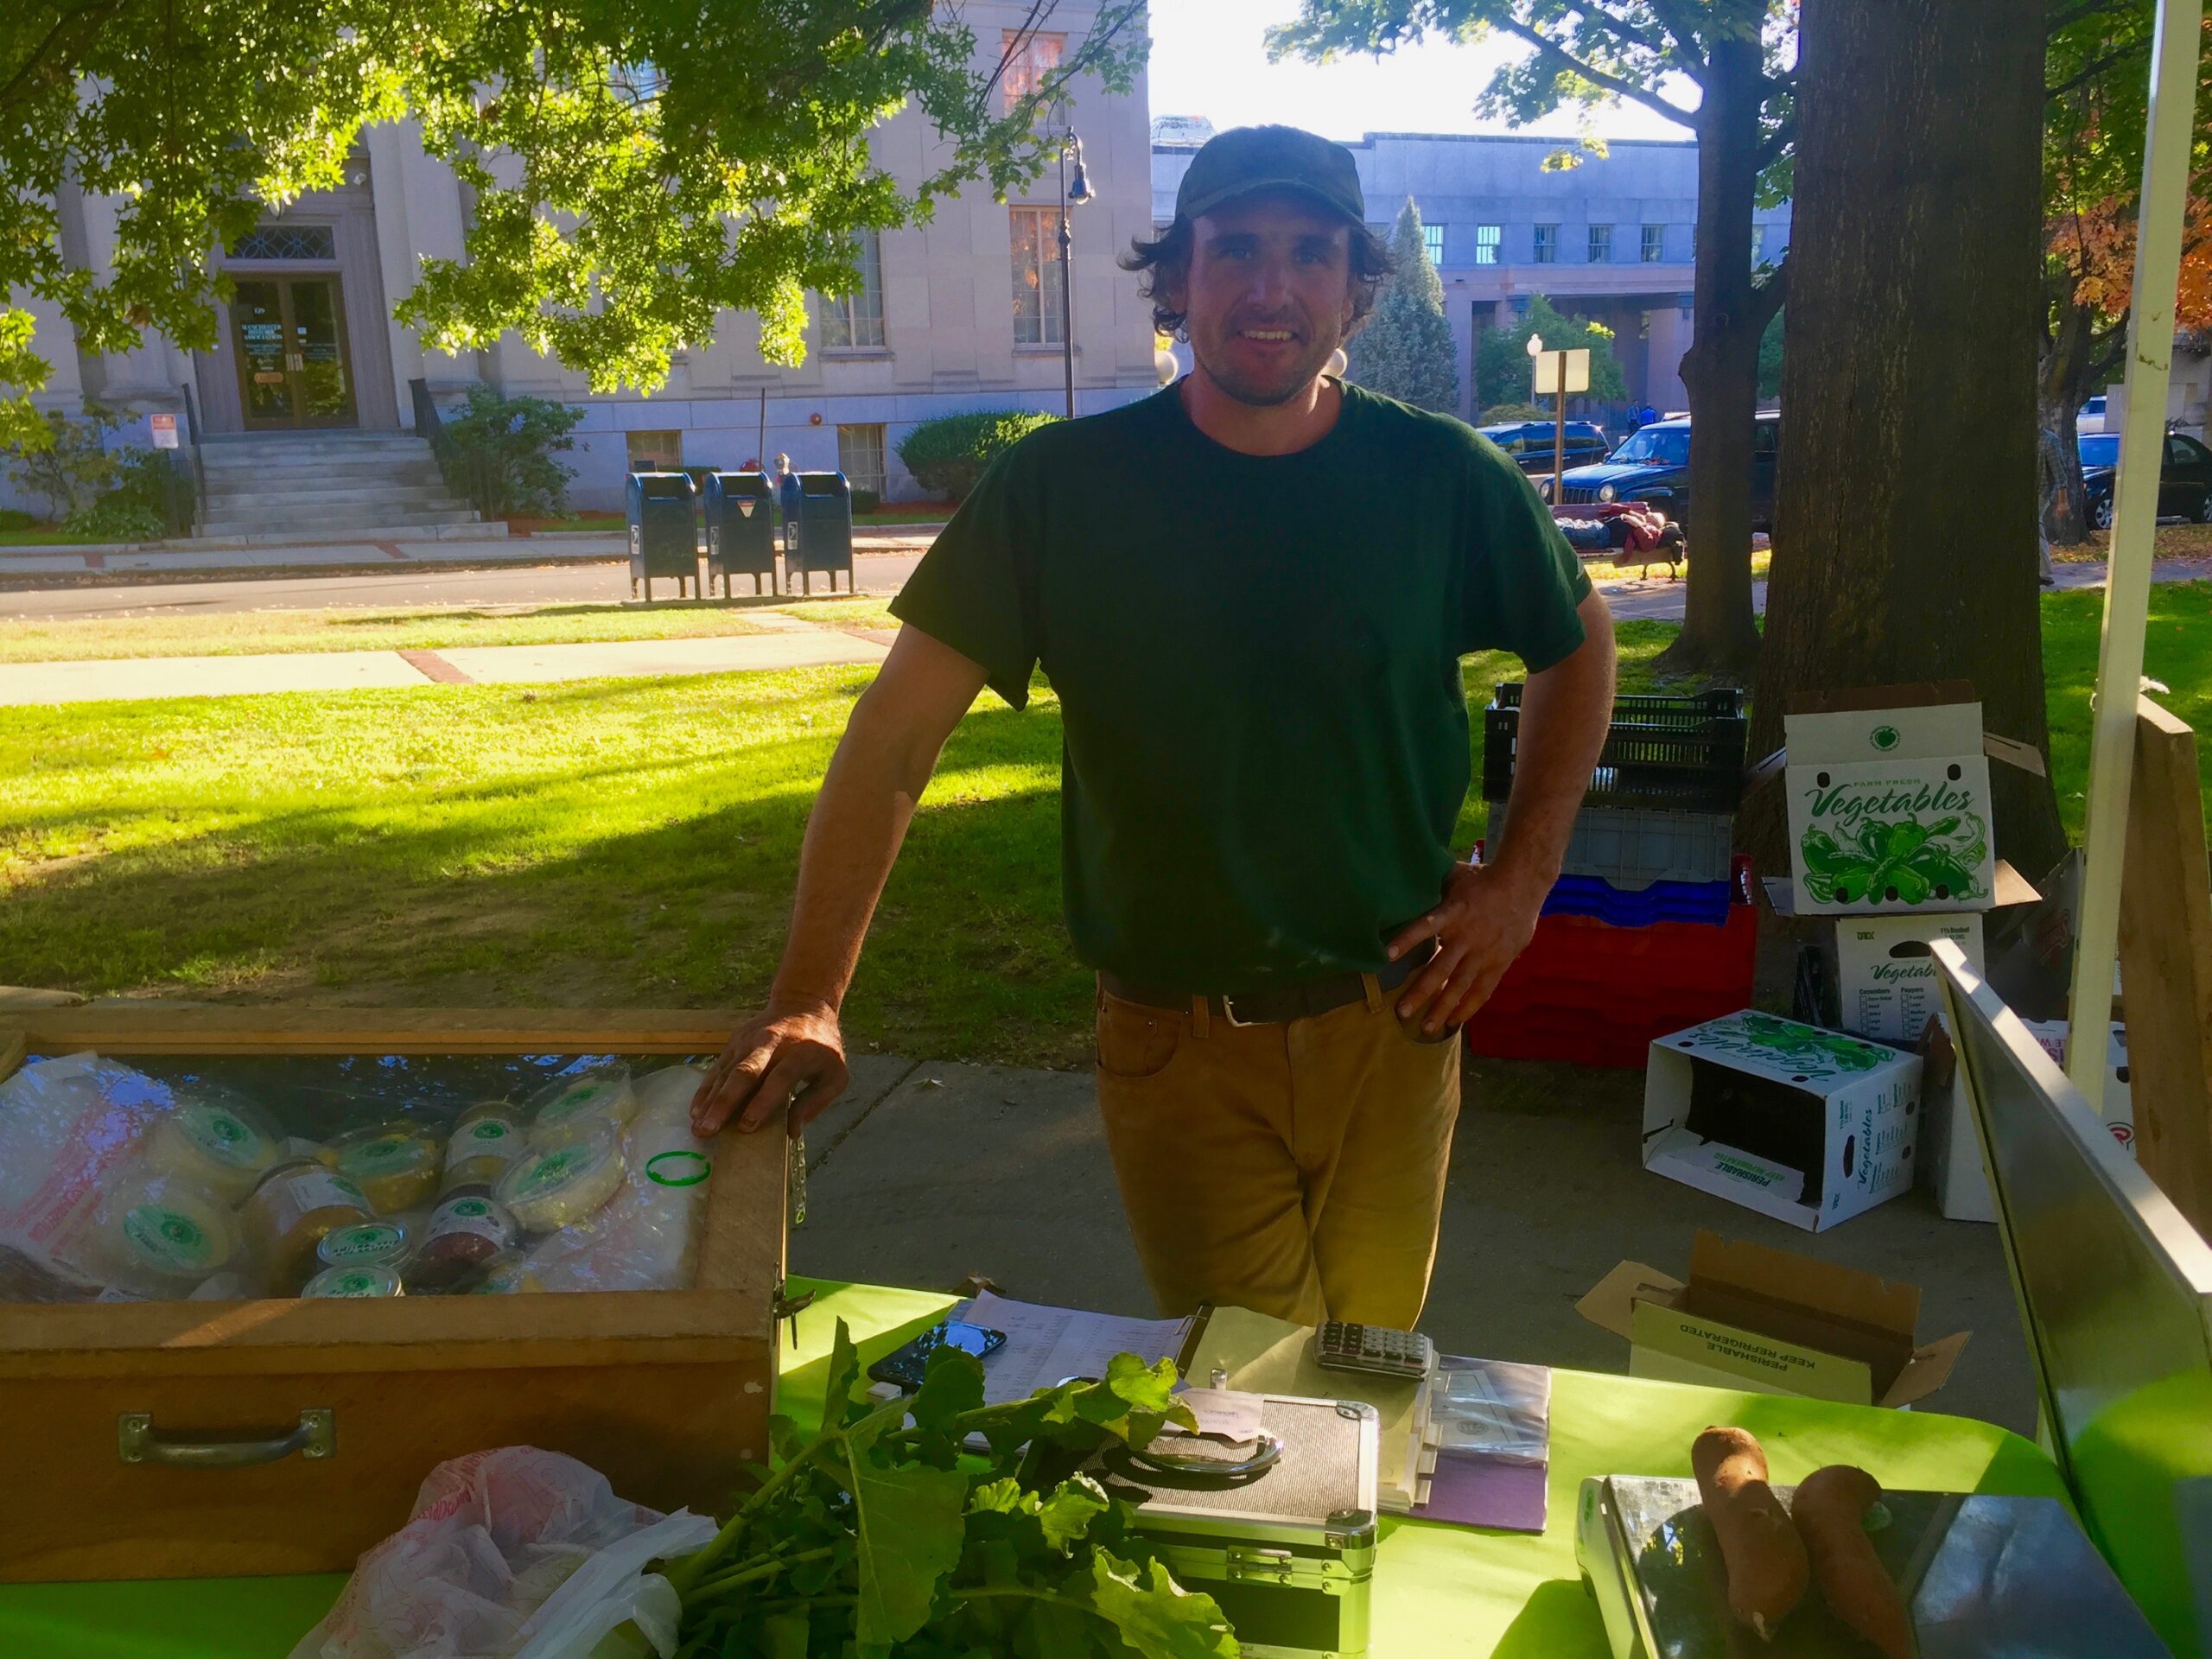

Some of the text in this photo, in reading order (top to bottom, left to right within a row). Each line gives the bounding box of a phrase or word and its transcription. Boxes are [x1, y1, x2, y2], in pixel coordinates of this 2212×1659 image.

[1804, 781, 1974, 827] Vegetables
[1870, 963, 1936, 985] Vegetab
[1858, 1107, 1873, 1190] Vegetables
[1715, 1161, 1771, 1187] PERISHABLE
[1681, 1325, 1815, 1370] KEEP REFRIGERATED
[1707, 1342, 1788, 1371] PERISHABLE
